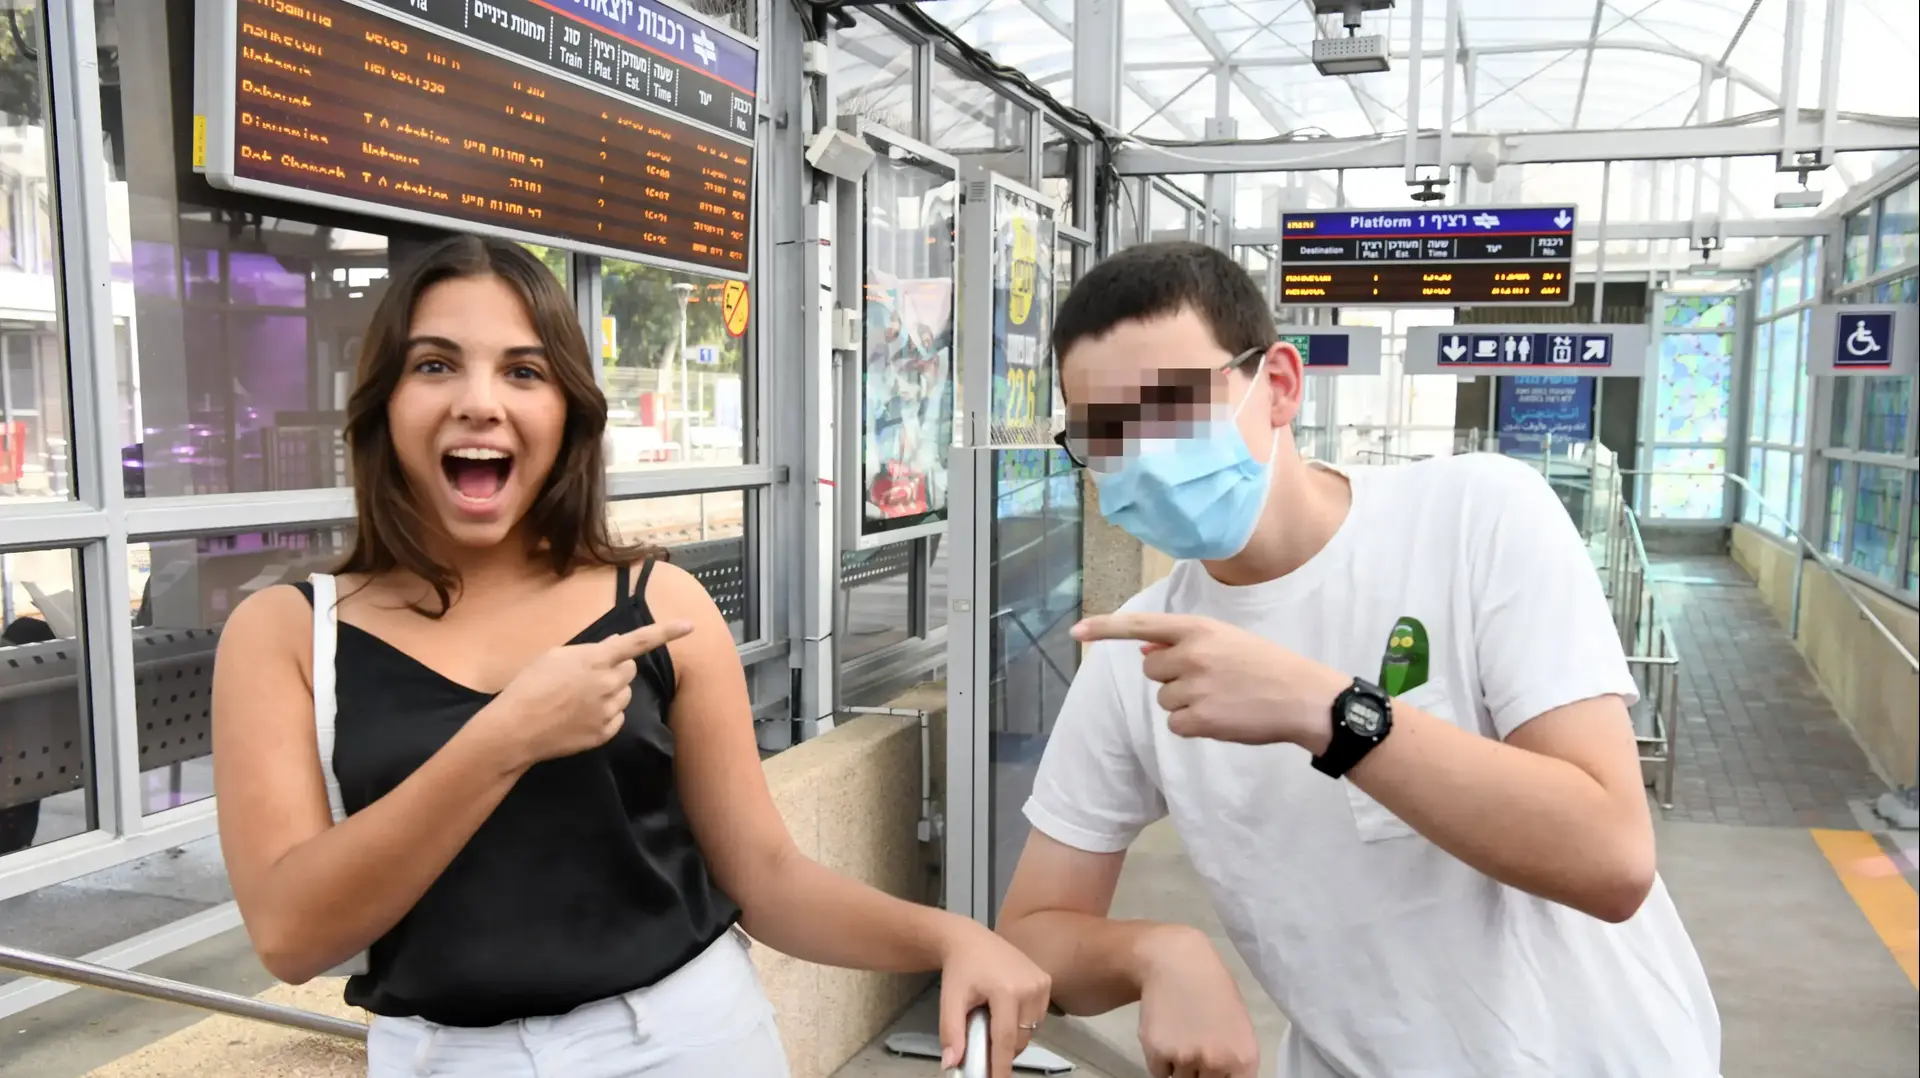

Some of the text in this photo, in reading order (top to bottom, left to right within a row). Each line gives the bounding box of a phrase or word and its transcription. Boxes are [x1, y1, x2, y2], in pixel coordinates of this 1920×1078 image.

[474, 0, 545, 43] תחנות ביניים
[573, 0, 684, 50] רכבות יוצא
[563, 26, 581, 46] סוג
[560, 46, 583, 69] Train
[593, 38, 616, 61] רציף
[594, 60, 612, 81] Plat.
[653, 62, 674, 83] שעה
[625, 72, 641, 91] Est.
[653, 83, 672, 103] Time
[699, 90, 712, 106] יעד
[734, 96, 752, 116] רכבת
[736, 115, 747, 132] No.
[1350, 215, 1425, 229] Platform 1
[1431, 213, 1467, 230] רציף
[1300, 246, 1344, 255] Destination
[1361, 240, 1383, 250] רציף
[1427, 239, 1450, 249] שעה
[1485, 244, 1502, 253] יעד
[1538, 237, 1563, 247] רכבת
[1427, 249, 1448, 258] Time
